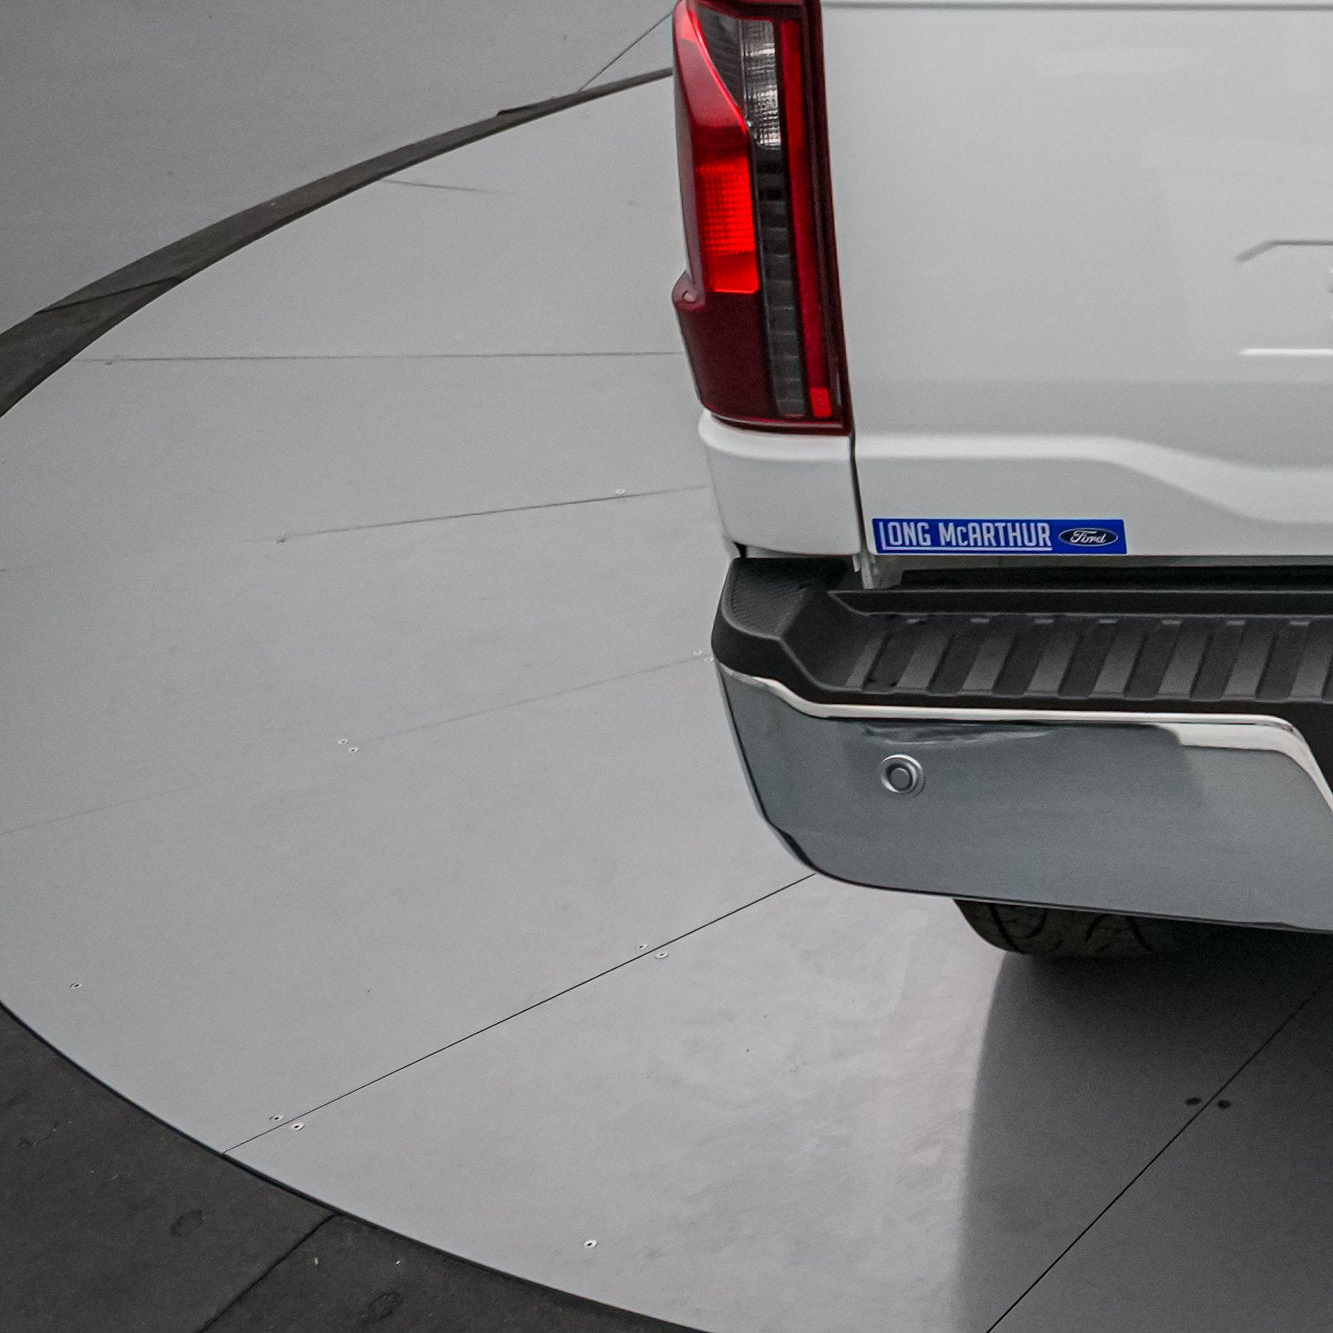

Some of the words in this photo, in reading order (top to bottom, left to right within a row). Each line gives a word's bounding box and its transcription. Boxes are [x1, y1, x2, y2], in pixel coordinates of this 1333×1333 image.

[879, 521, 934, 550] LONG
[938, 521, 1053, 547] McARTHUR
[1070, 529, 1107, 546] Ford
